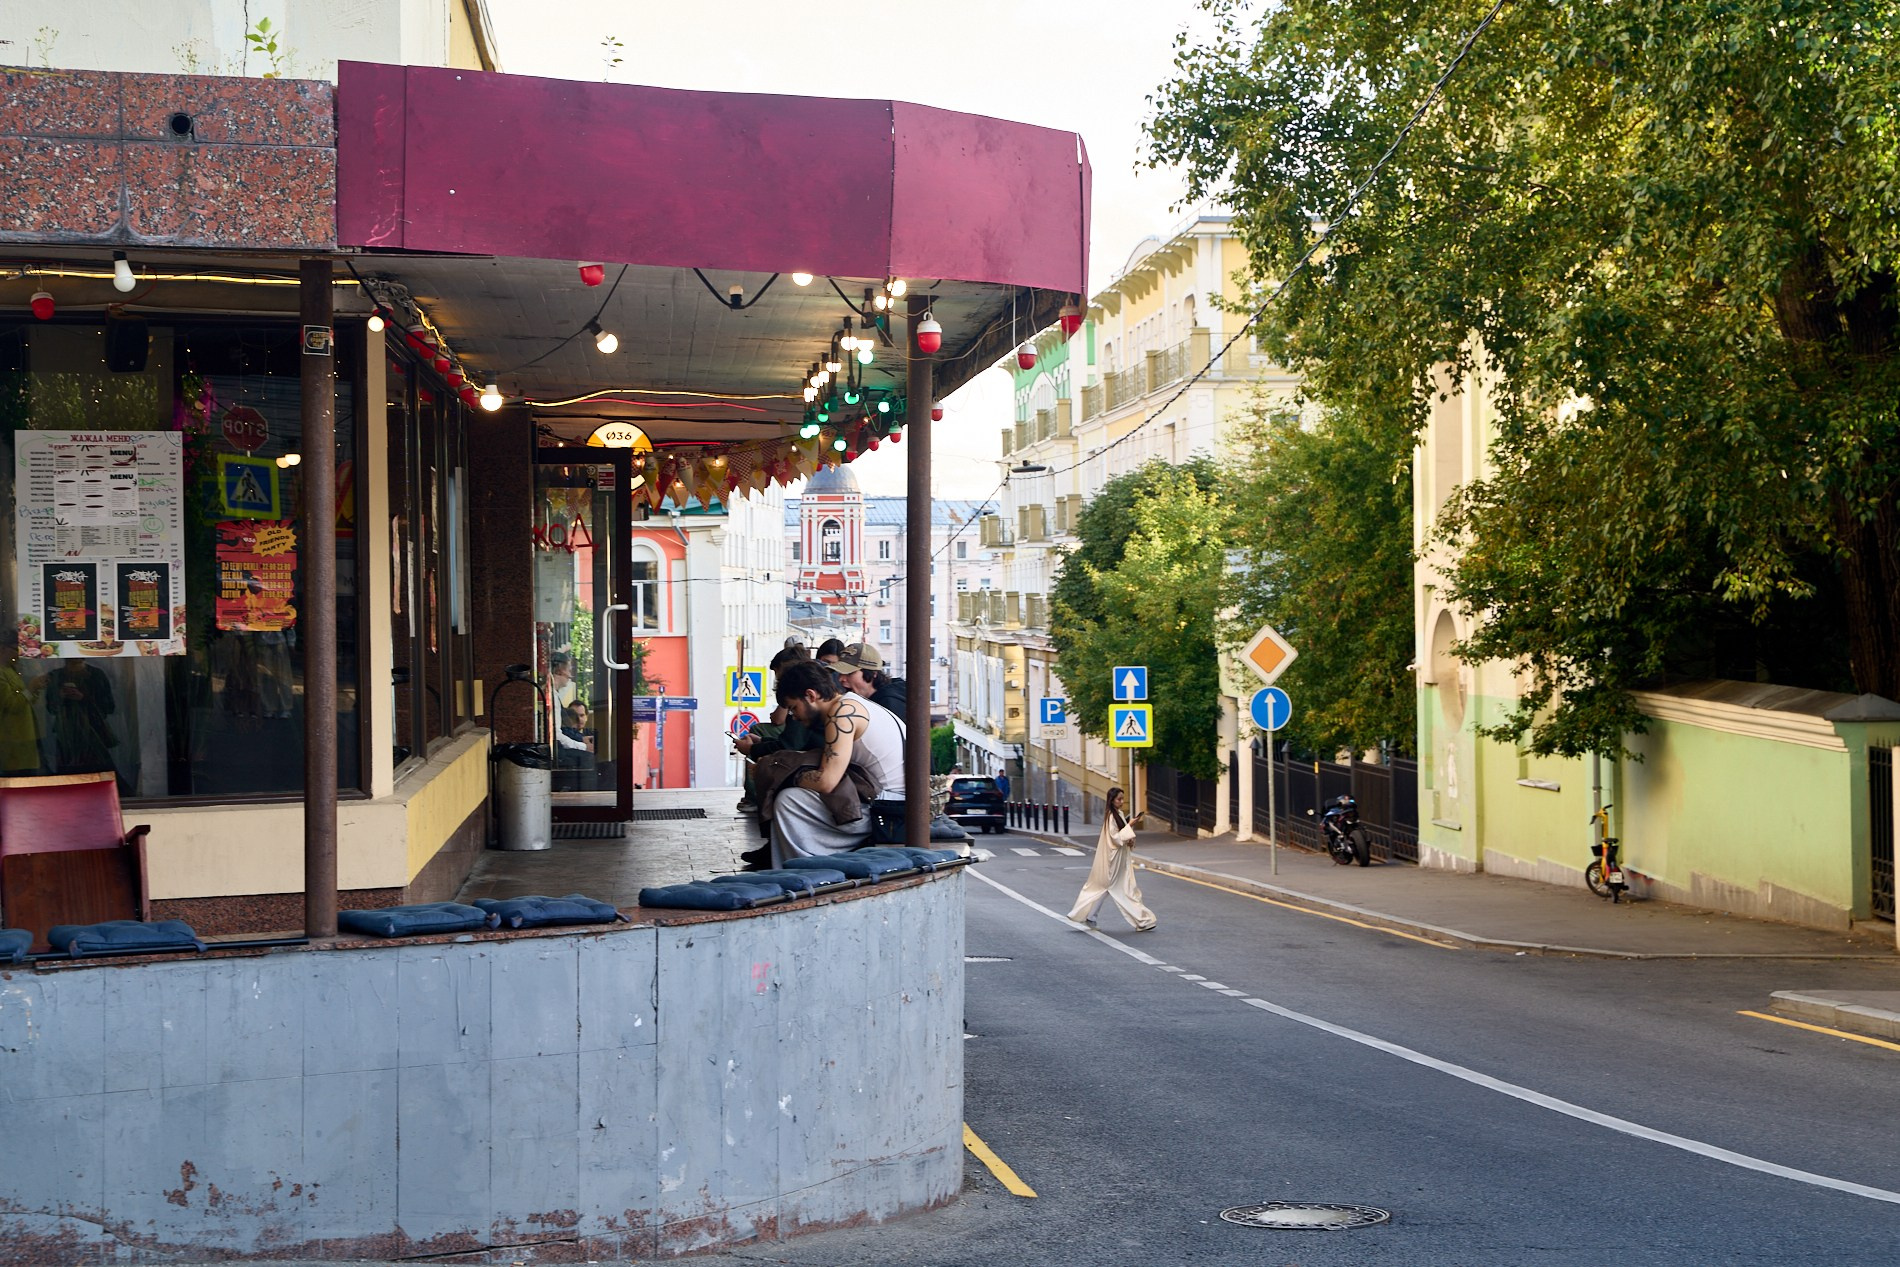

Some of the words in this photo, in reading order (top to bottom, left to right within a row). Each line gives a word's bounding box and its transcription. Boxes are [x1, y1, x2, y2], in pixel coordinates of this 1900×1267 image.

[70, 434, 104, 443] ЖАЖДА
[259, 535, 290, 546] FRIENDS
[262, 541, 287, 553] PARTY
[1046, 700, 1062, 722] P
